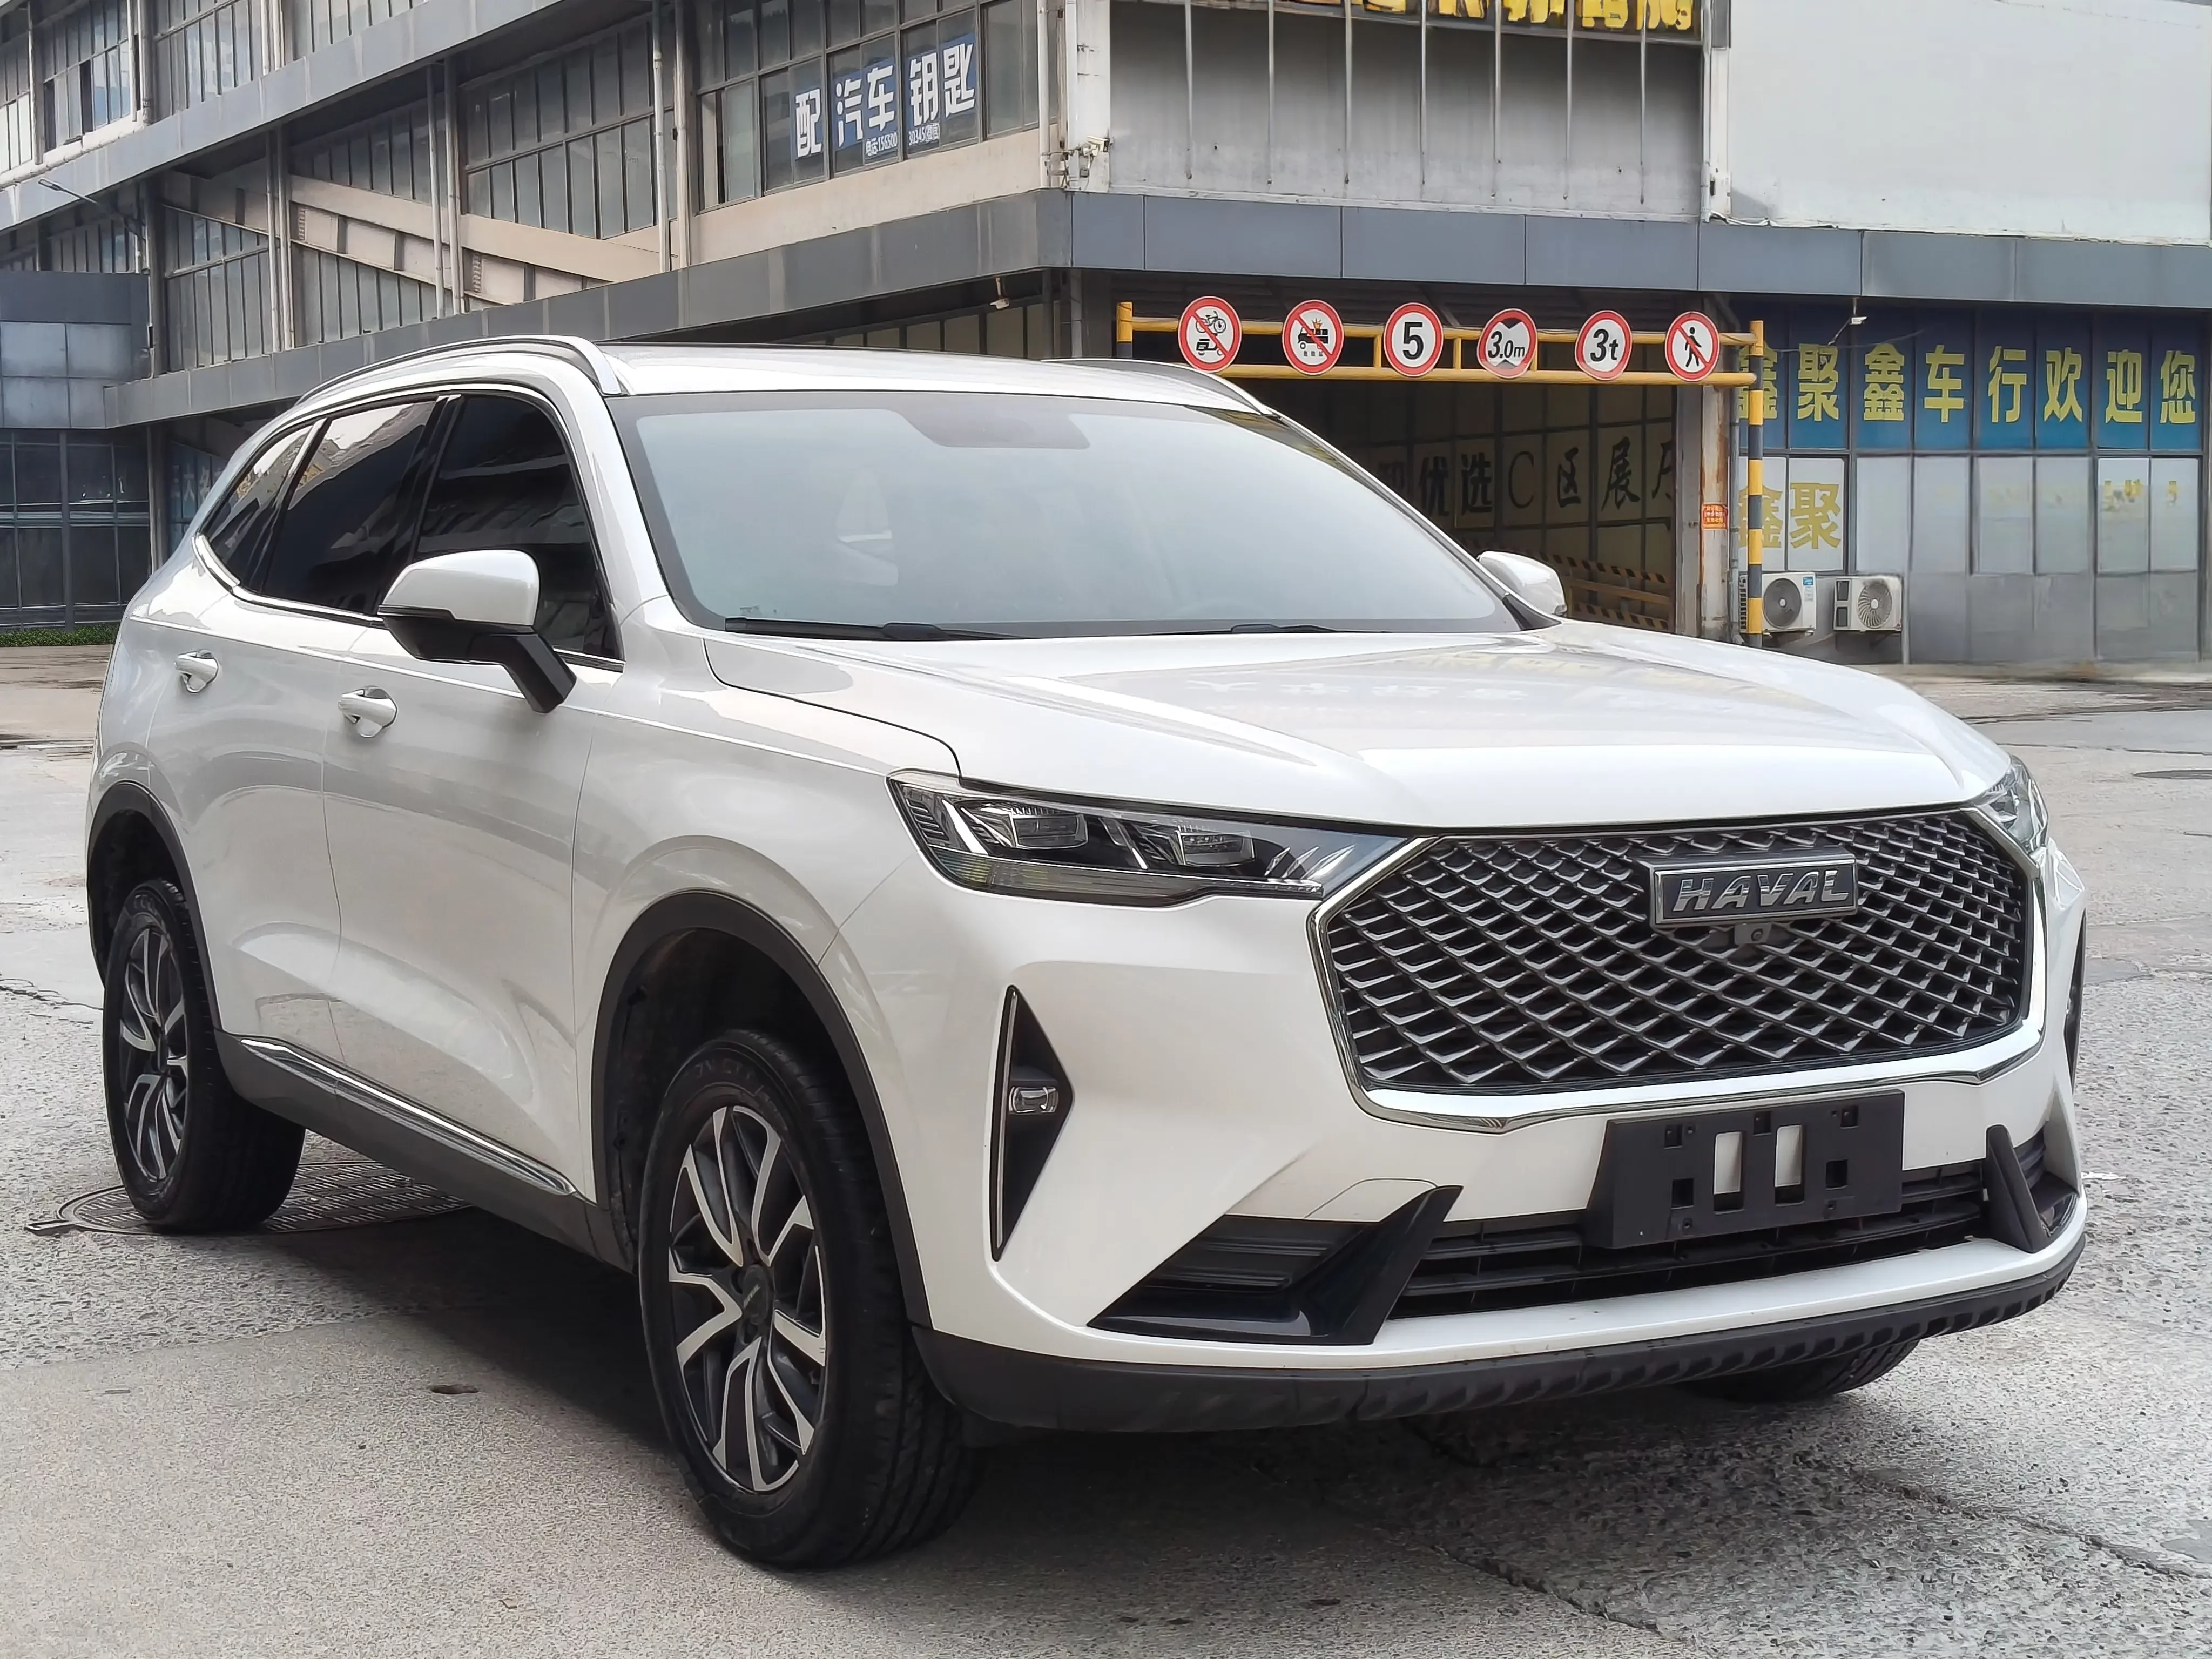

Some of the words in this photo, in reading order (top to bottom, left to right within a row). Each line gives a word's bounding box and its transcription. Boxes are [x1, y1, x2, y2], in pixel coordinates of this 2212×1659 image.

[795, 43, 975, 158] 配汽车钥匙
[1402, 321, 1424, 360] 5
[1487, 331, 1526, 359] 3.0m
[1590, 328, 1619, 362] 3t
[1738, 343, 2196, 424] 鑫聚鑫车行欢迎您
[1672, 869, 1850, 912] HAVAL
